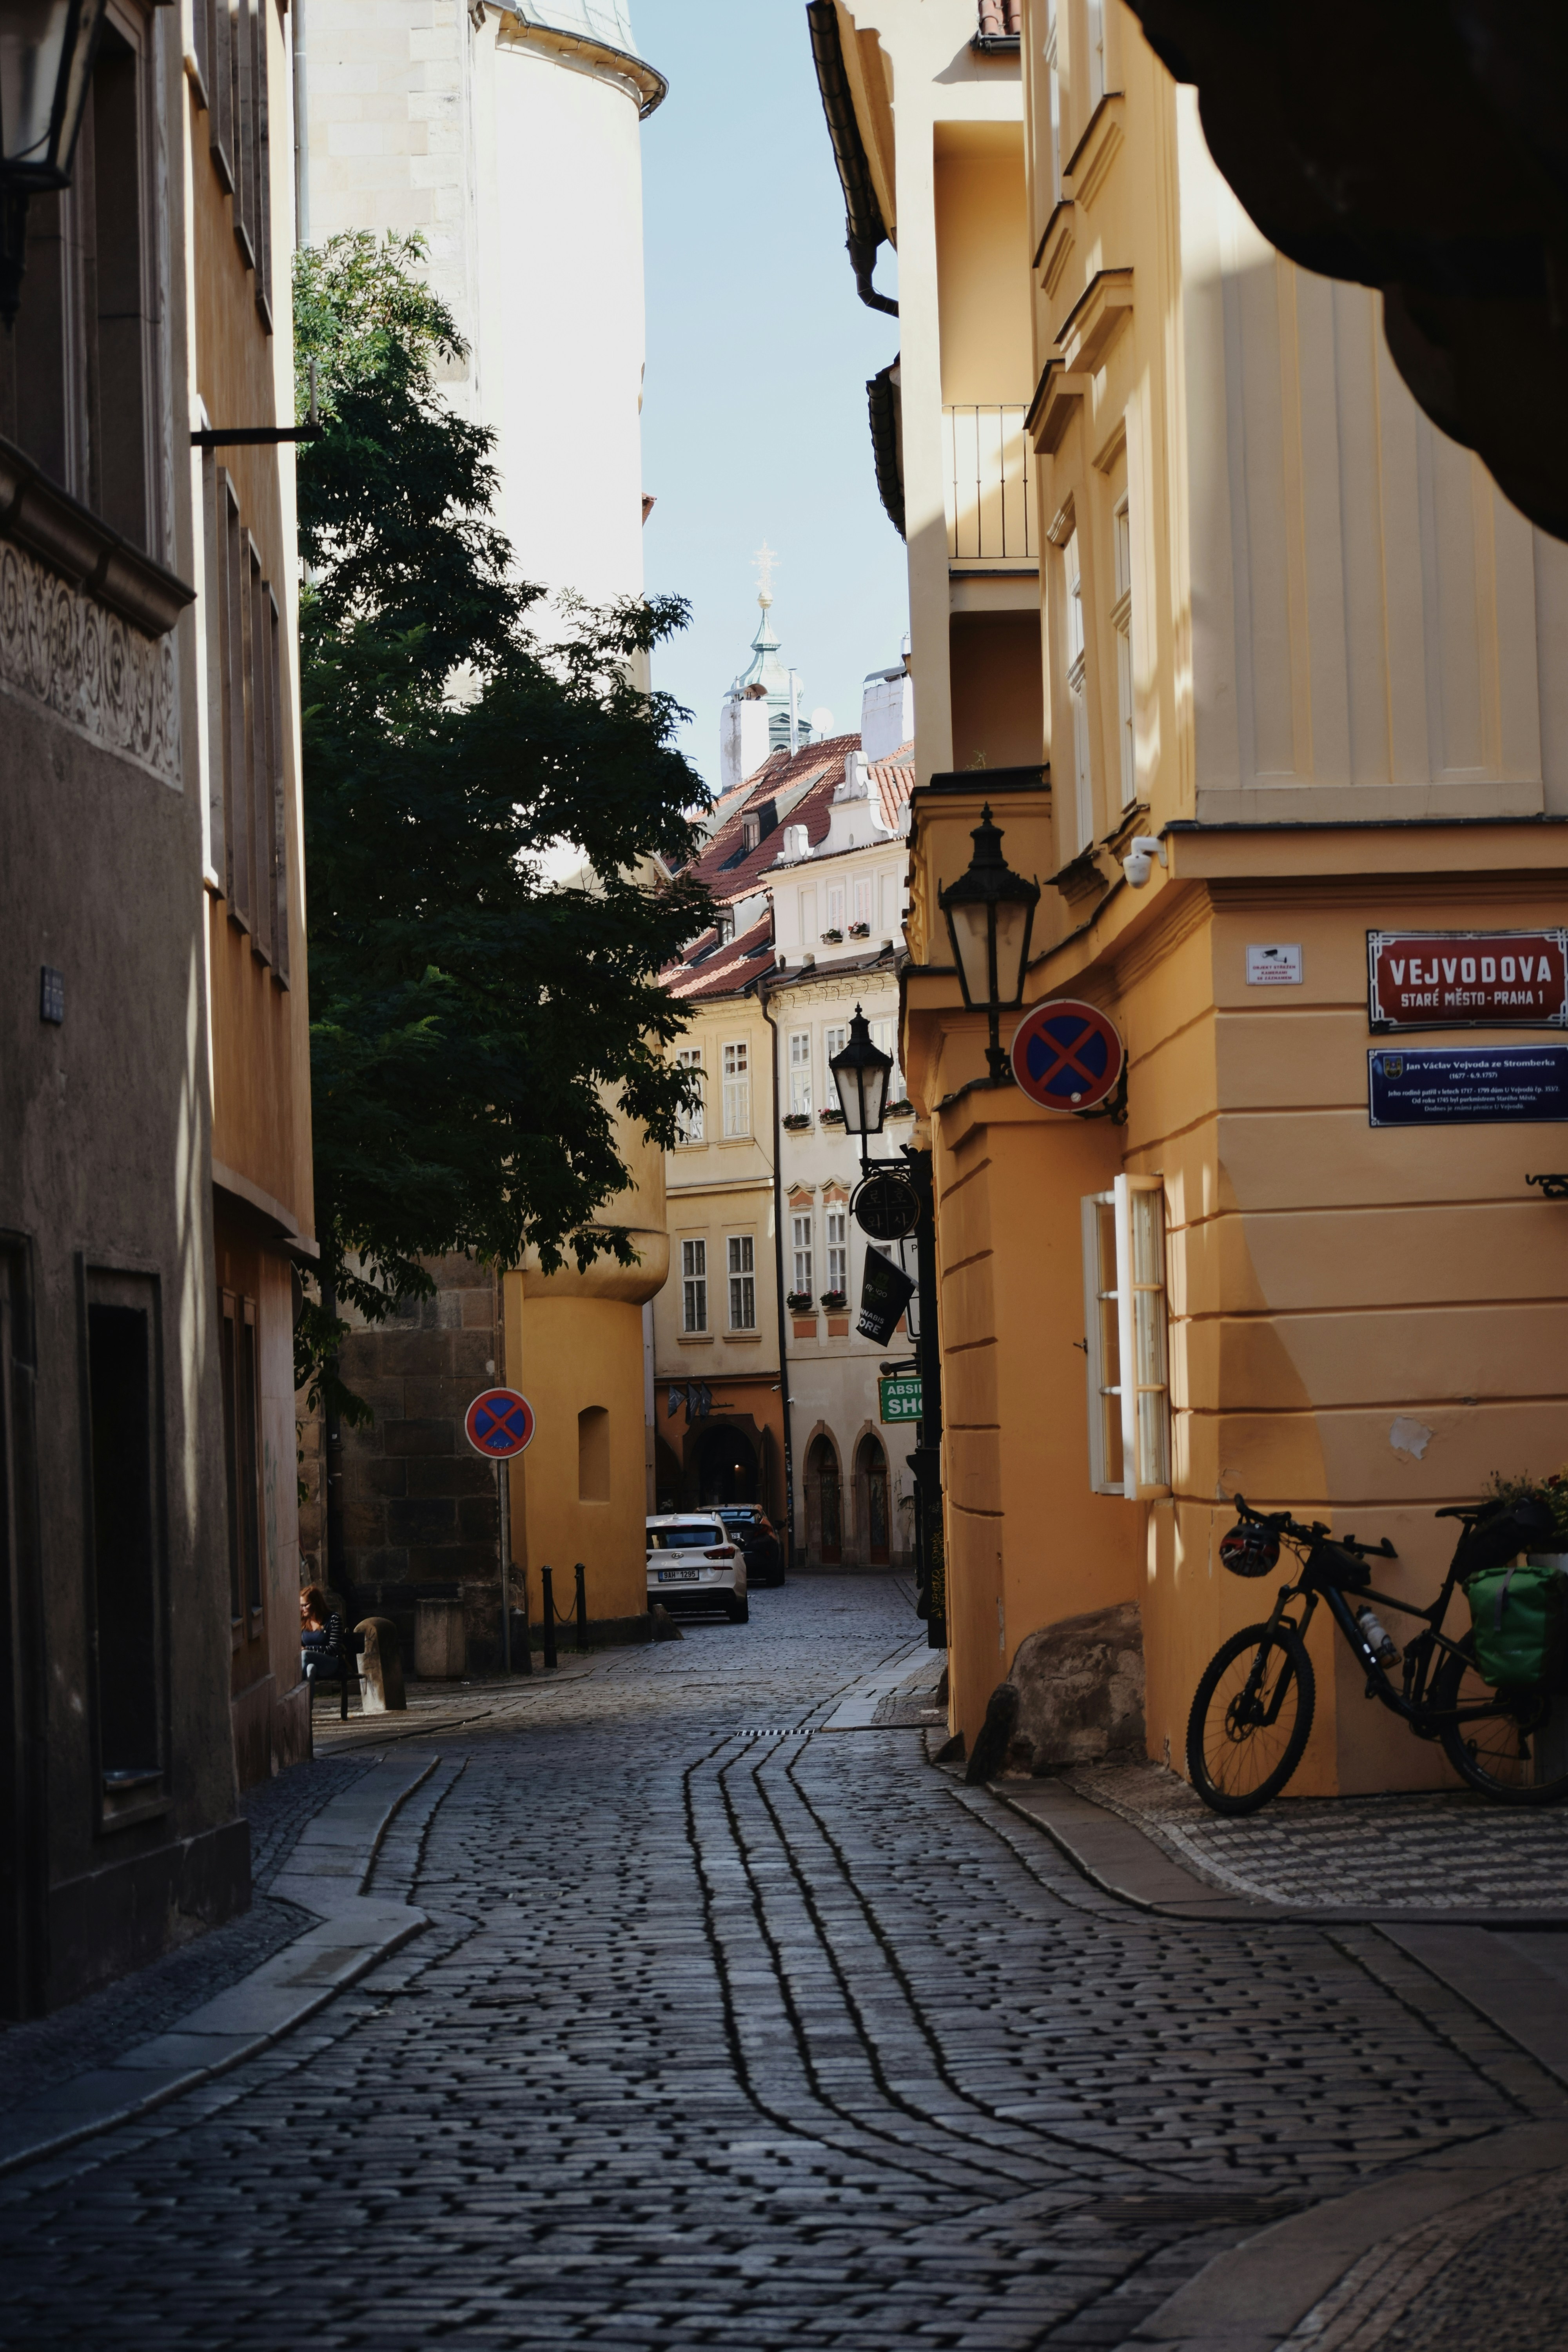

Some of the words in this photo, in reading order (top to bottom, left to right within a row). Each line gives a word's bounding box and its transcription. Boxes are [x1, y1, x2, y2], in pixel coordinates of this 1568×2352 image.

[1390, 956, 1552, 985] VEJVODOVA
[1401, 988, 1439, 1007] STARÉ
[1445, 987, 1485, 1006] MĚSTO
[1494, 991, 1533, 1005] PRAHA
[1538, 991, 1543, 1004] 1
[1453, 1061, 1489, 1070] Vejvoda
[1504, 1059, 1555, 1067] Stromberka
[1459, 1096, 1495, 1104] purkmistrem
[875, 1288, 887, 1298] 420
[859, 1317, 882, 1335] ORE
[888, 1398, 922, 1414] SH
